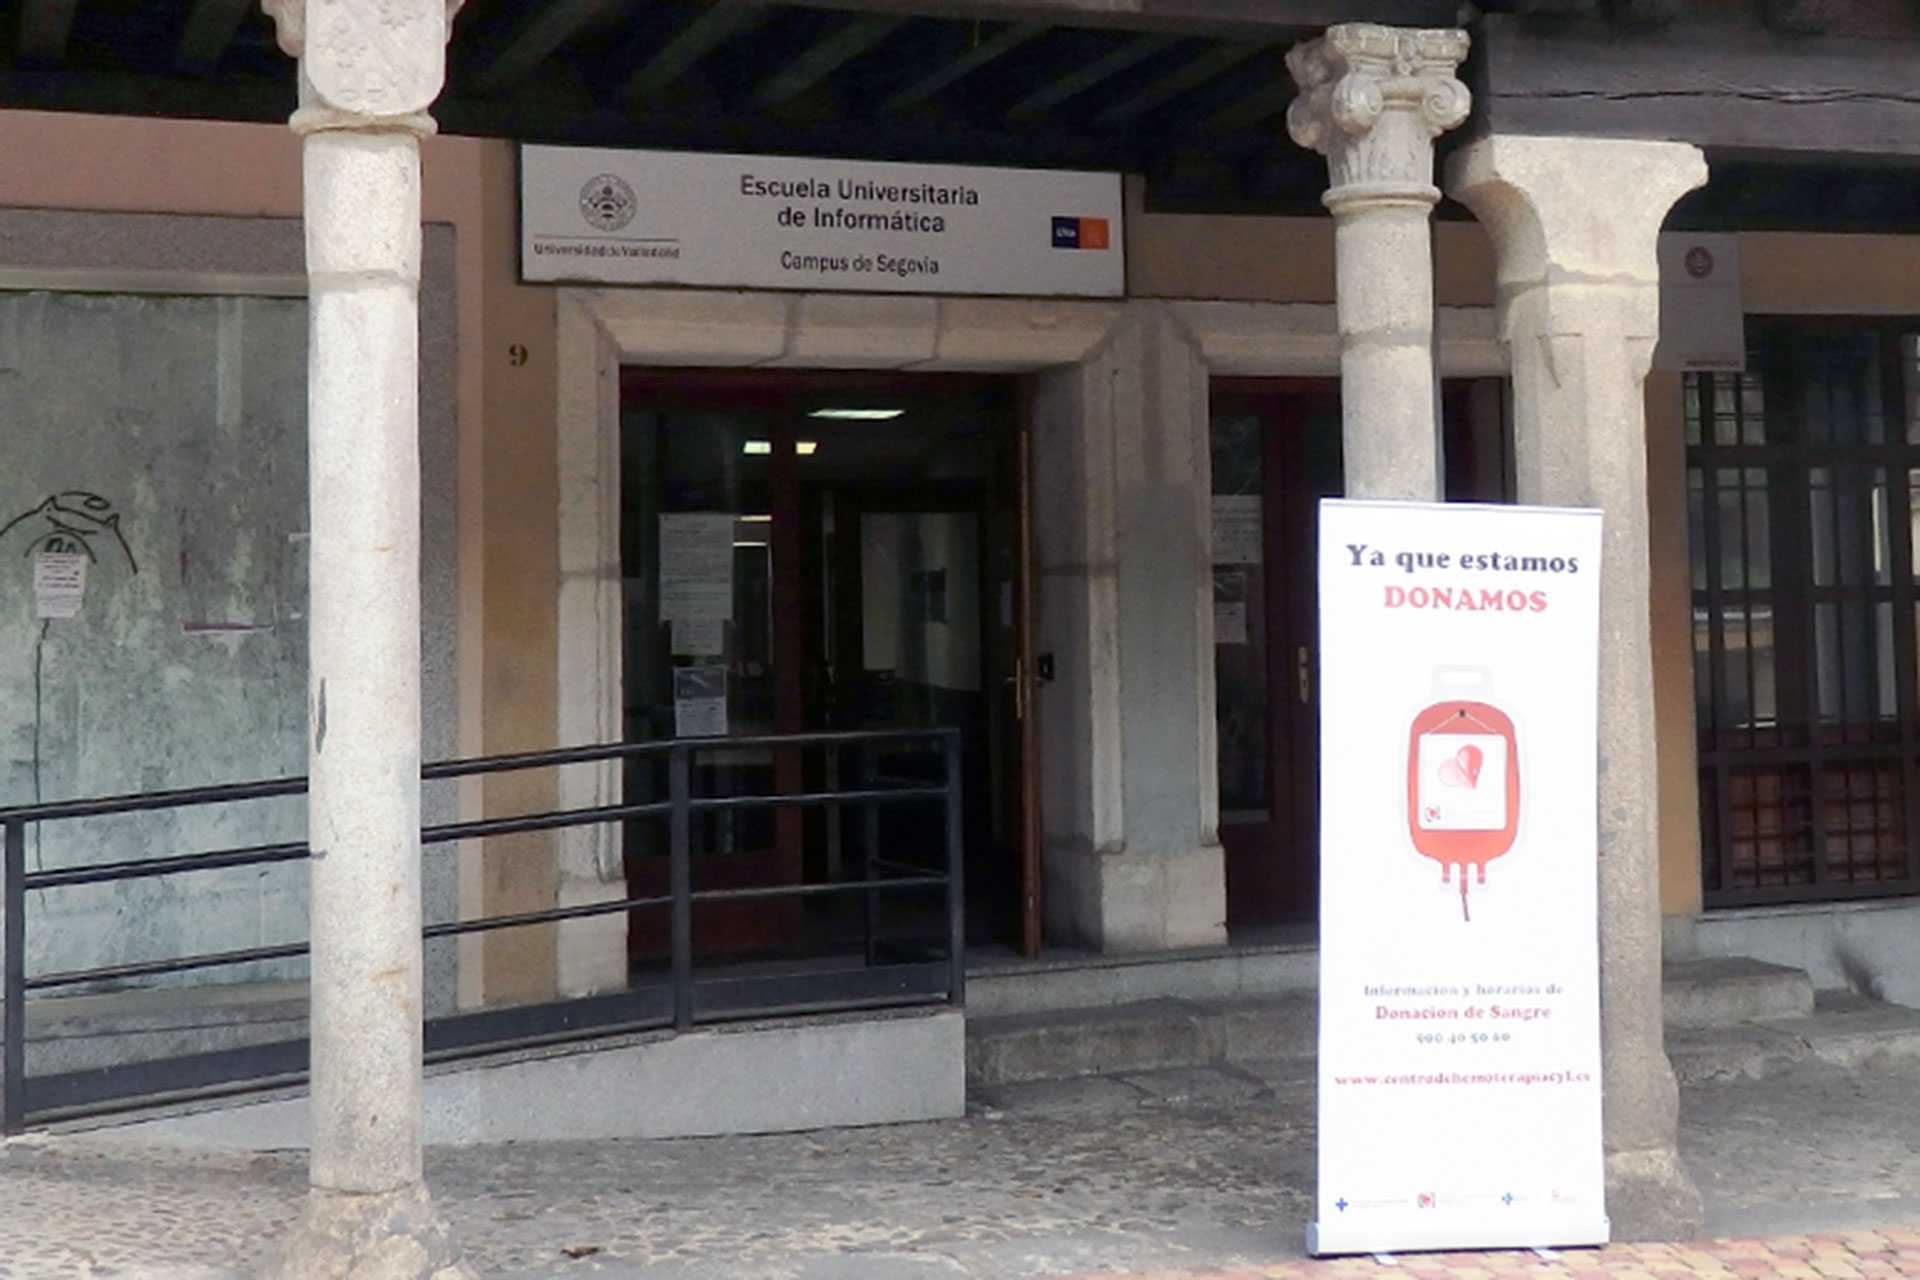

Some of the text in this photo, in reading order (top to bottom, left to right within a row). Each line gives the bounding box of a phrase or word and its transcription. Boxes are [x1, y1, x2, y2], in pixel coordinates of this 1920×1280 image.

[741, 174, 979, 206] Escuela Universitaria
[777, 207, 946, 233] de Informática
[781, 250, 939, 278] Campus de Segovia
[508, 344, 529, 367] 9
[1346, 544, 1580, 574] Ya que estamos
[1384, 585, 1548, 613] DONAMOS
[1462, 987, 1470, 998] y
[1546, 983, 1564, 996] de
[1464, 1006, 1486, 1020] de
[1489, 1006, 1551, 1021] Sangre
[1470, 1032, 1489, 1044] 50
